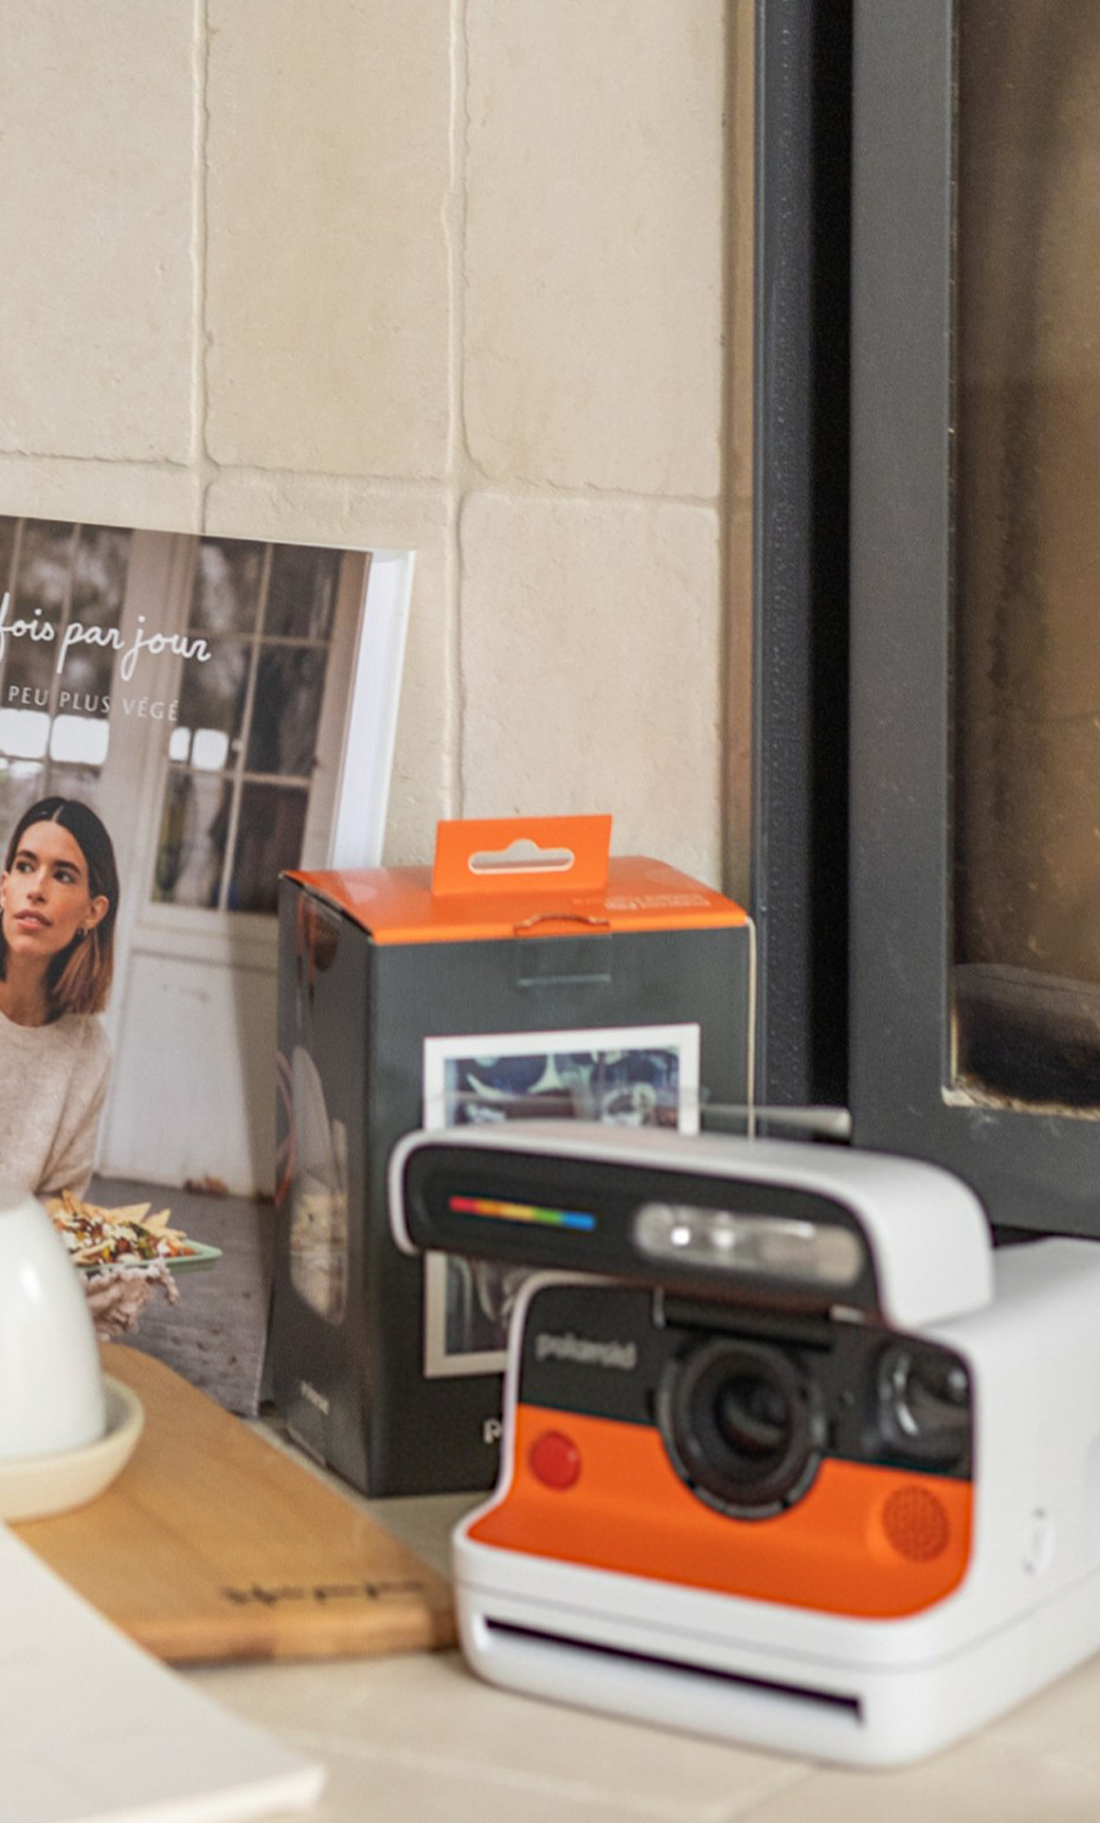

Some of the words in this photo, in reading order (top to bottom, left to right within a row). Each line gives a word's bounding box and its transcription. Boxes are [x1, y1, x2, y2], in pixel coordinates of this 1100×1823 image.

[57, 622, 125, 674] par
[120, 615, 212, 681] jour
[8, 685, 48, 706] PEU
[59, 691, 111, 714] PLUS
[122, 696, 180, 722] VÉGÉ
